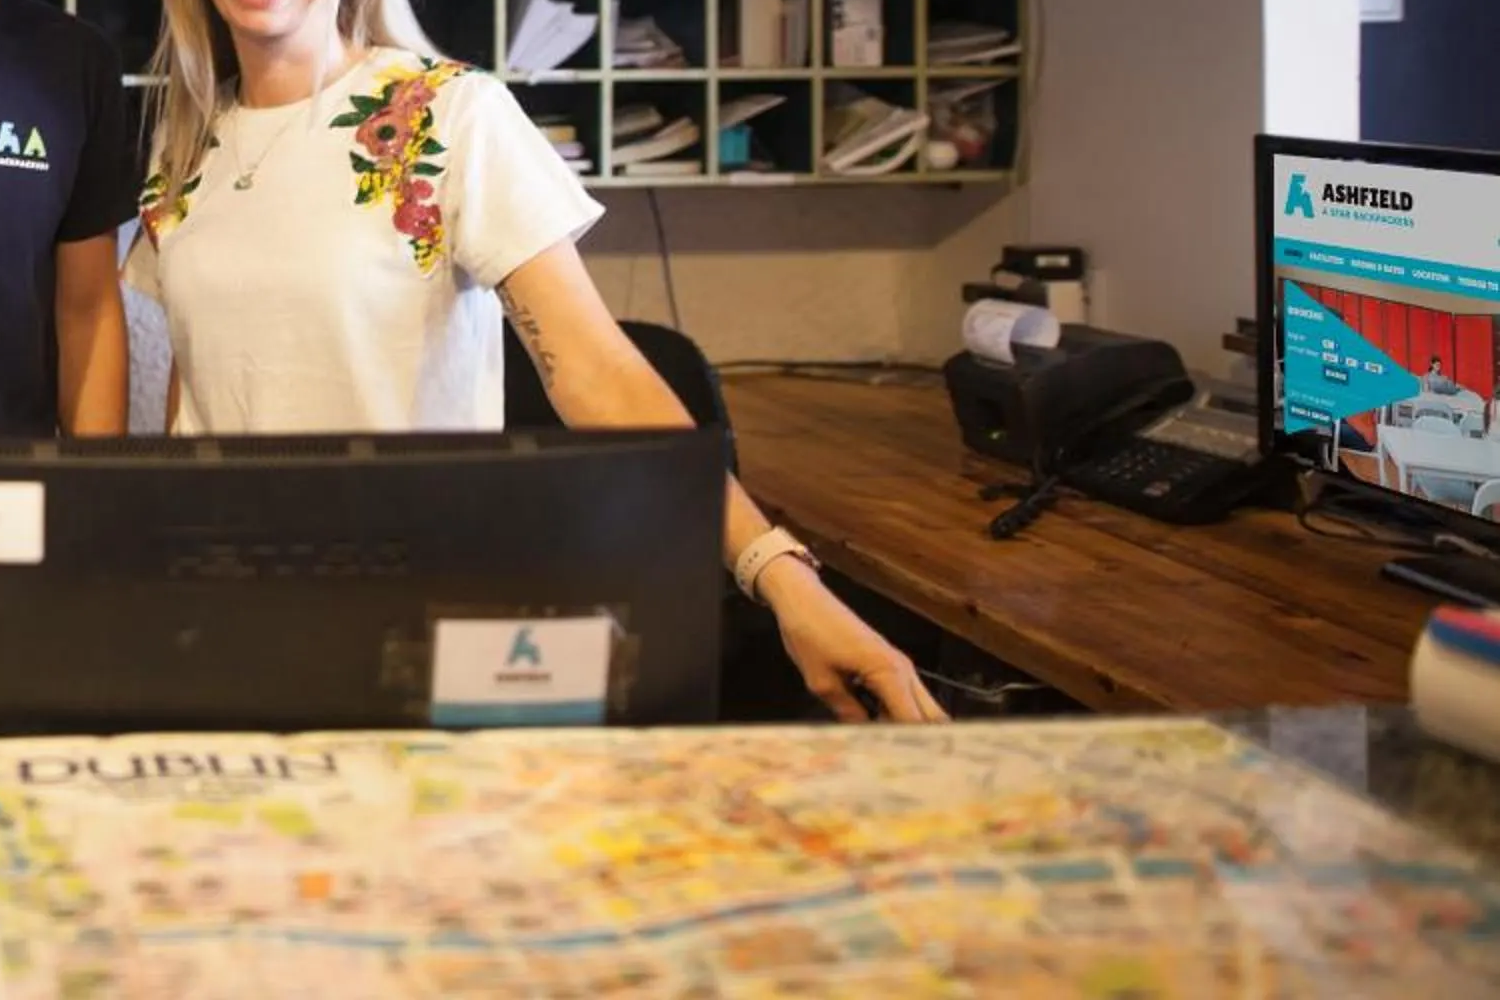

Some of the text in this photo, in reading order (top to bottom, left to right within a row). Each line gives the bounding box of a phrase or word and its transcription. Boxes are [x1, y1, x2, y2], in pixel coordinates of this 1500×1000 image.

[1322, 183, 1413, 211] ASHFIELD
[1321, 208, 1415, 228] A STAR BACKPACKERS
[1412, 269, 1450, 282] LOCATION
[17, 753, 337, 784] DUBLIN
